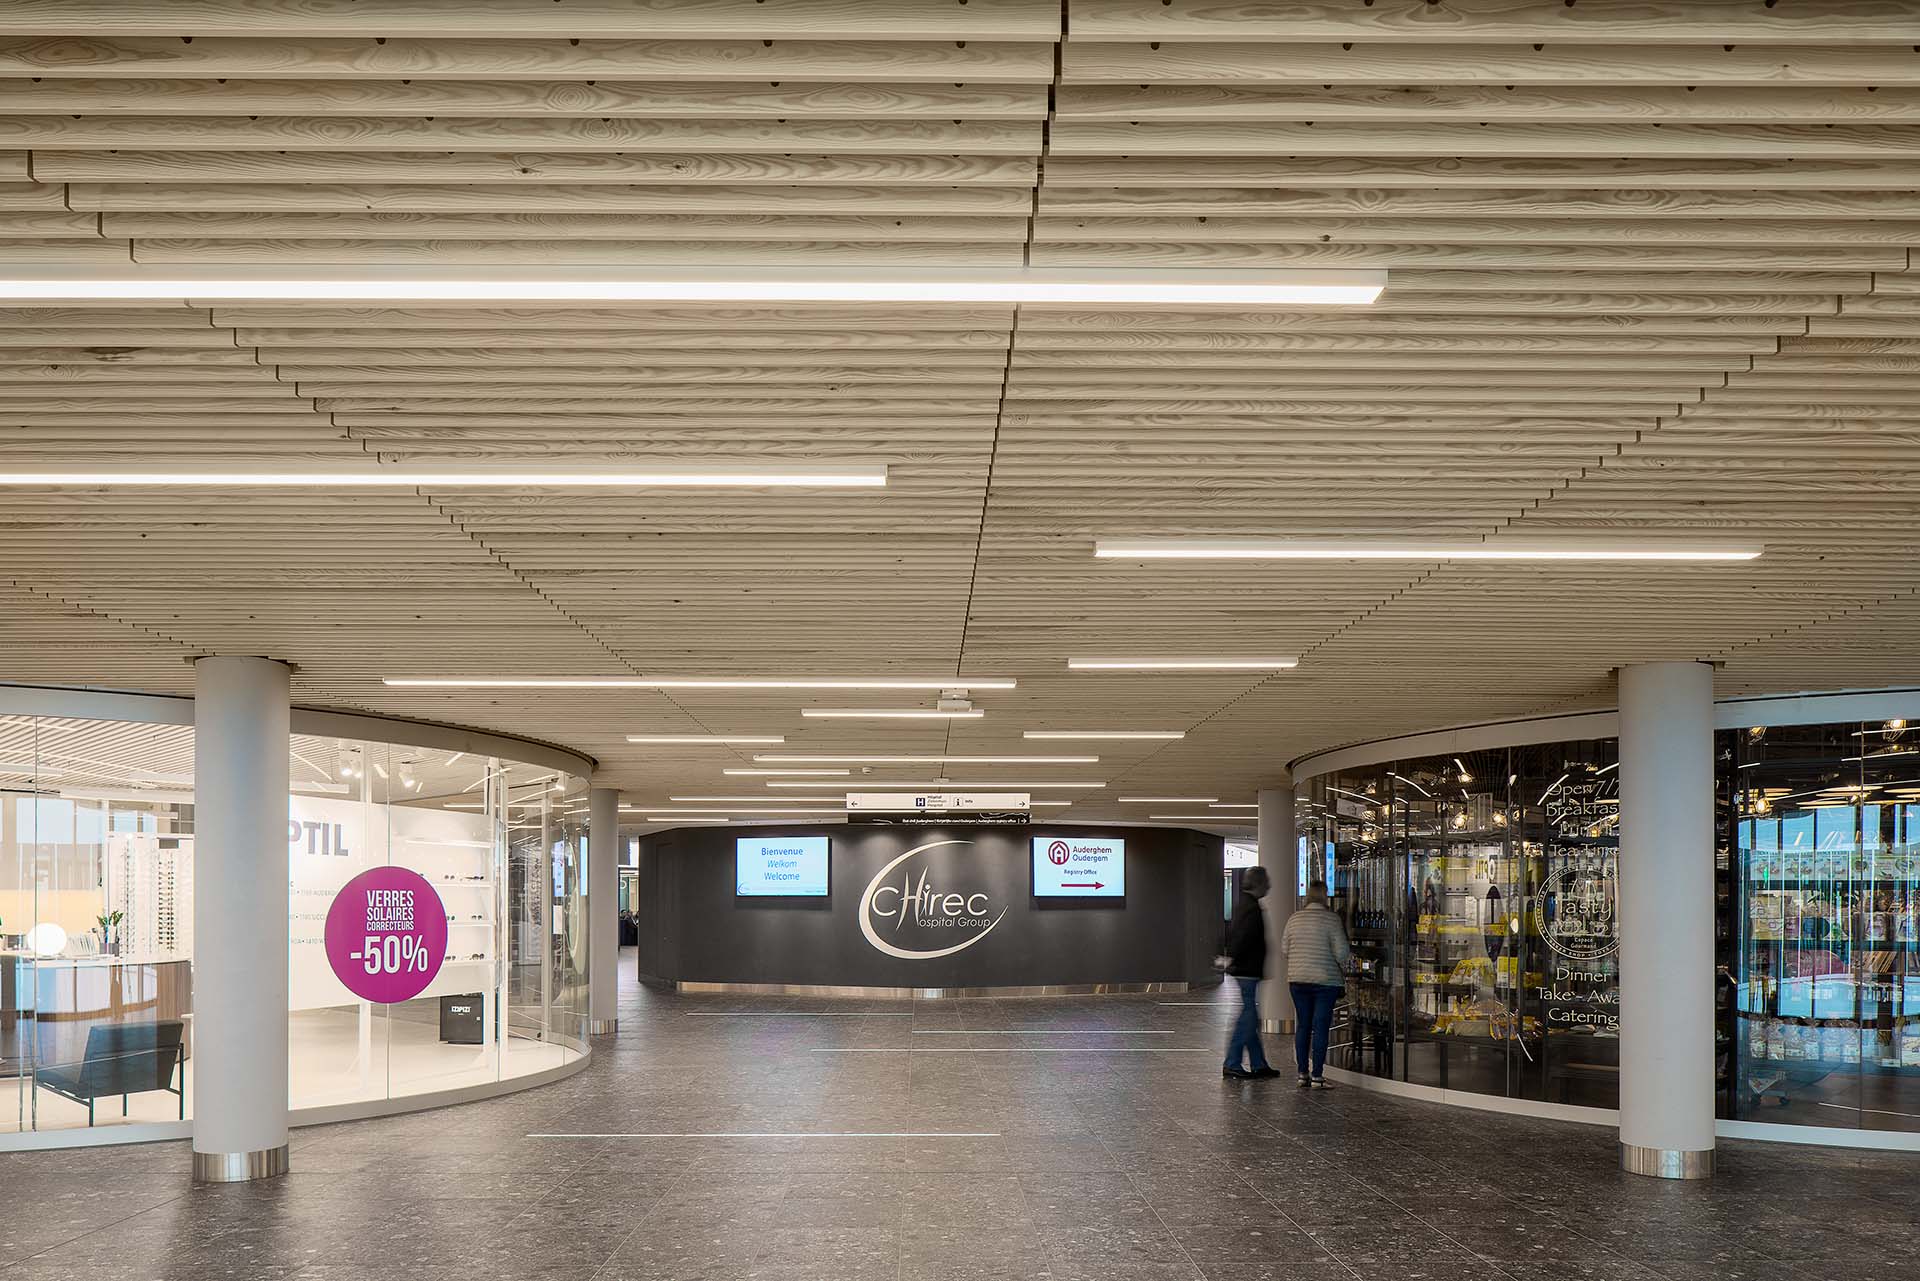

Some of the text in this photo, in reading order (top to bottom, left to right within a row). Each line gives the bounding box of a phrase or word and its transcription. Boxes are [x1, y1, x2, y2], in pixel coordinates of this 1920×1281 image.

[1546, 783, 1592, 803] Open
[1560, 822, 1613, 836] Lunh
[761, 847, 804, 856] Bienvenue
[1072, 846, 1112, 854] Auderghem
[767, 859, 798, 868] Welkom
[1072, 854, 1109, 863] Oudergem
[764, 872, 800, 881] Welcome
[366, 890, 414, 907] VERRES
[366, 907, 414, 921] SOLAIRES
[1554, 896, 1613, 921] Tasty
[366, 921, 414, 931] CORRECTEURS
[958, 917, 991, 929] Group
[350, 935, 428, 975] -50%
[1556, 967, 1611, 983] Dinner
[1536, 983, 1572, 1001] Take
[1548, 1007, 1619, 1031] Catering
